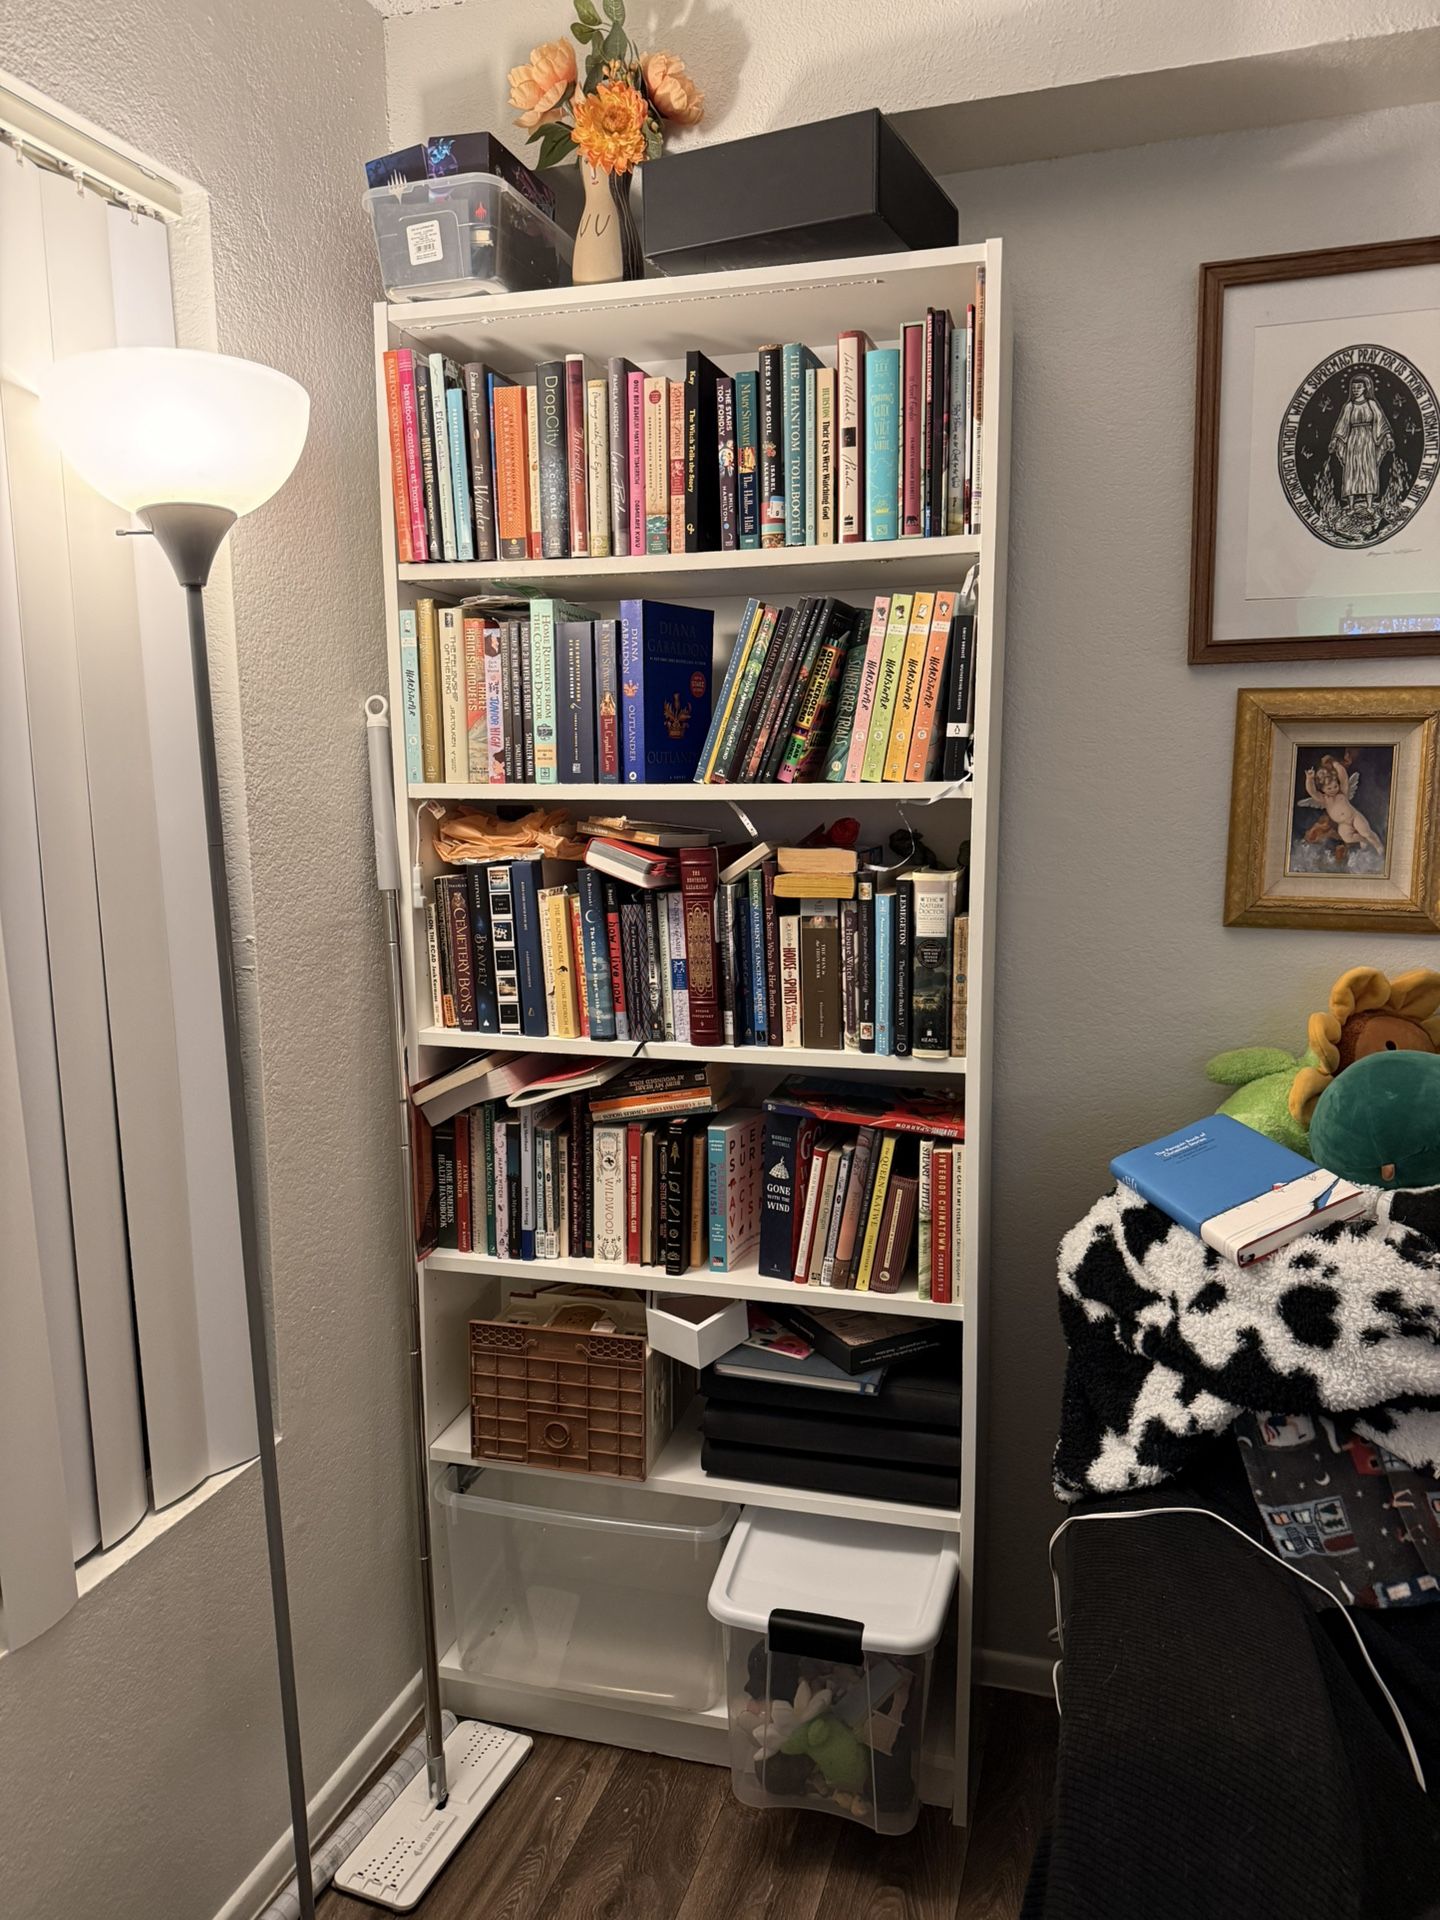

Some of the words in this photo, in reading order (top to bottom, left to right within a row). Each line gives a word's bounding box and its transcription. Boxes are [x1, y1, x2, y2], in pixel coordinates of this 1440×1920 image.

[790, 351, 799, 381] THE
[844, 352, 857, 381] Isabel
[1309, 351, 1354, 389] SUPREMACY
[1358, 350, 1379, 362] PRAY
[1380, 353, 1395, 367] FOR
[1395, 363, 1408, 376] US
[387, 358, 398, 405] BAREFOOT
[688, 370, 696, 385] Kay
[765, 379, 771, 392] OF
[1404, 371, 1426, 400] TRYING
[403, 384, 413, 425] barefoot
[741, 384, 749, 409] MARY
[765, 394, 772, 409] MY
[823, 388, 831, 418] HURSTON
[844, 382, 857, 422] Allende
[1290, 388, 1312, 419] WHITE
[1421, 396, 1433, 410] TO
[391, 406, 401, 446] CONTESSA
[742, 411, 751, 446] STEWART
[791, 385, 800, 451] PHANTOM
[407, 427, 416, 470] contessa
[822, 440, 830, 455] Eyes
[1283, 420, 1297, 457] WITHOUT
[1423, 410, 1439, 457] DISMANTLE
[394, 447, 404, 486] FAMILY
[573, 427, 583, 484] Aphrodite
[1419, 458, 1435, 481] THIS
[410, 473, 417, 483] at
[474, 464, 483, 481] The
[687, 475, 695, 492] Story
[744, 475, 753, 487] The
[843, 455, 858, 488] Paula
[1283, 456, 1302, 499] CONCEIVED
[397, 487, 406, 517] STYLE
[744, 489, 753, 514] Hollow
[791, 457, 800, 536] TOLLBOOTH
[821, 473, 831, 504] Watching
[1408, 483, 1426, 504] SHIT
[475, 485, 489, 532] Wonder
[1295, 498, 1315, 524] MARY
[1312, 519, 1320, 528] O
[744, 516, 754, 533] Hills
[542, 614, 551, 644] HOME
[659, 622, 696, 638] DIANA
[467, 628, 476, 668] HAINISH
[534, 634, 542, 678] COUNTRY
[647, 639, 708, 657] GABALDON
[814, 648, 828, 676] MYTH
[542, 646, 552, 692] REMEDIES
[602, 659, 610, 691] STEWART
[820, 651, 834, 680] QUEER
[468, 673, 476, 711] NOVELS
[839, 659, 862, 710] SUNBEARER
[861, 660, 877, 710] HEARTSTOPPER
[880, 658, 896, 710] HEARTSTOPPER
[902, 658, 919, 710] HEARTSTOPPER
[924, 656, 940, 708] HEARTSTOPPER
[490, 697, 499, 725] JUNIOR
[535, 683, 543, 720] DOCTOR
[798, 688, 816, 723] LEGEND
[810, 681, 825, 717] HEROES
[491, 728, 500, 747] HIGH
[835, 716, 852, 745] TRIALS
[785, 739, 796, 760] JONES
[793, 744, 802, 759] DAN
[752, 878, 760, 910] MODERN
[428, 919, 434, 930] ON
[608, 921, 618, 945] how
[753, 911, 762, 948] AILMENTS
[767, 922, 775, 940] Sister
[899, 894, 907, 945] LEMEGETON
[453, 907, 469, 976] CEMETERY
[474, 934, 487, 986] BRAVELY
[612, 955, 620, 977] live
[783, 947, 797, 970] HOUSE
[846, 956, 854, 981] Witch
[459, 979, 472, 1013] BOYS
[613, 983, 621, 1004] now
[768, 975, 776, 988] Her
[783, 978, 798, 1005] SPIRITS
[438, 1154, 446, 1184] HEALTH
[445, 1160, 453, 1183] HOME
[486, 1153, 492, 1161] OF
[878, 1156, 890, 1188] QUEEN
[921, 1146, 931, 1179] STUART
[710, 1163, 718, 1216] ACTIVISM
[767, 1183, 791, 1196] GONE
[938, 1154, 947, 1196] INTERIOR
[439, 1185, 447, 1228] HANDBOOK
[446, 1185, 454, 1223] REMEDIES
[605, 1177, 614, 1235] WILDWOOD
[767, 1201, 790, 1213] WIND
[824, 1184, 833, 1206] Eugene
[921, 1182, 931, 1212] LITTLE
[819, 1208, 831, 1230] Onegin
[870, 1195, 882, 1228] KATWE
[938, 1200, 946, 1251] CHINATOWN
[828, 1206, 841, 1254] TRANSFORMATION
